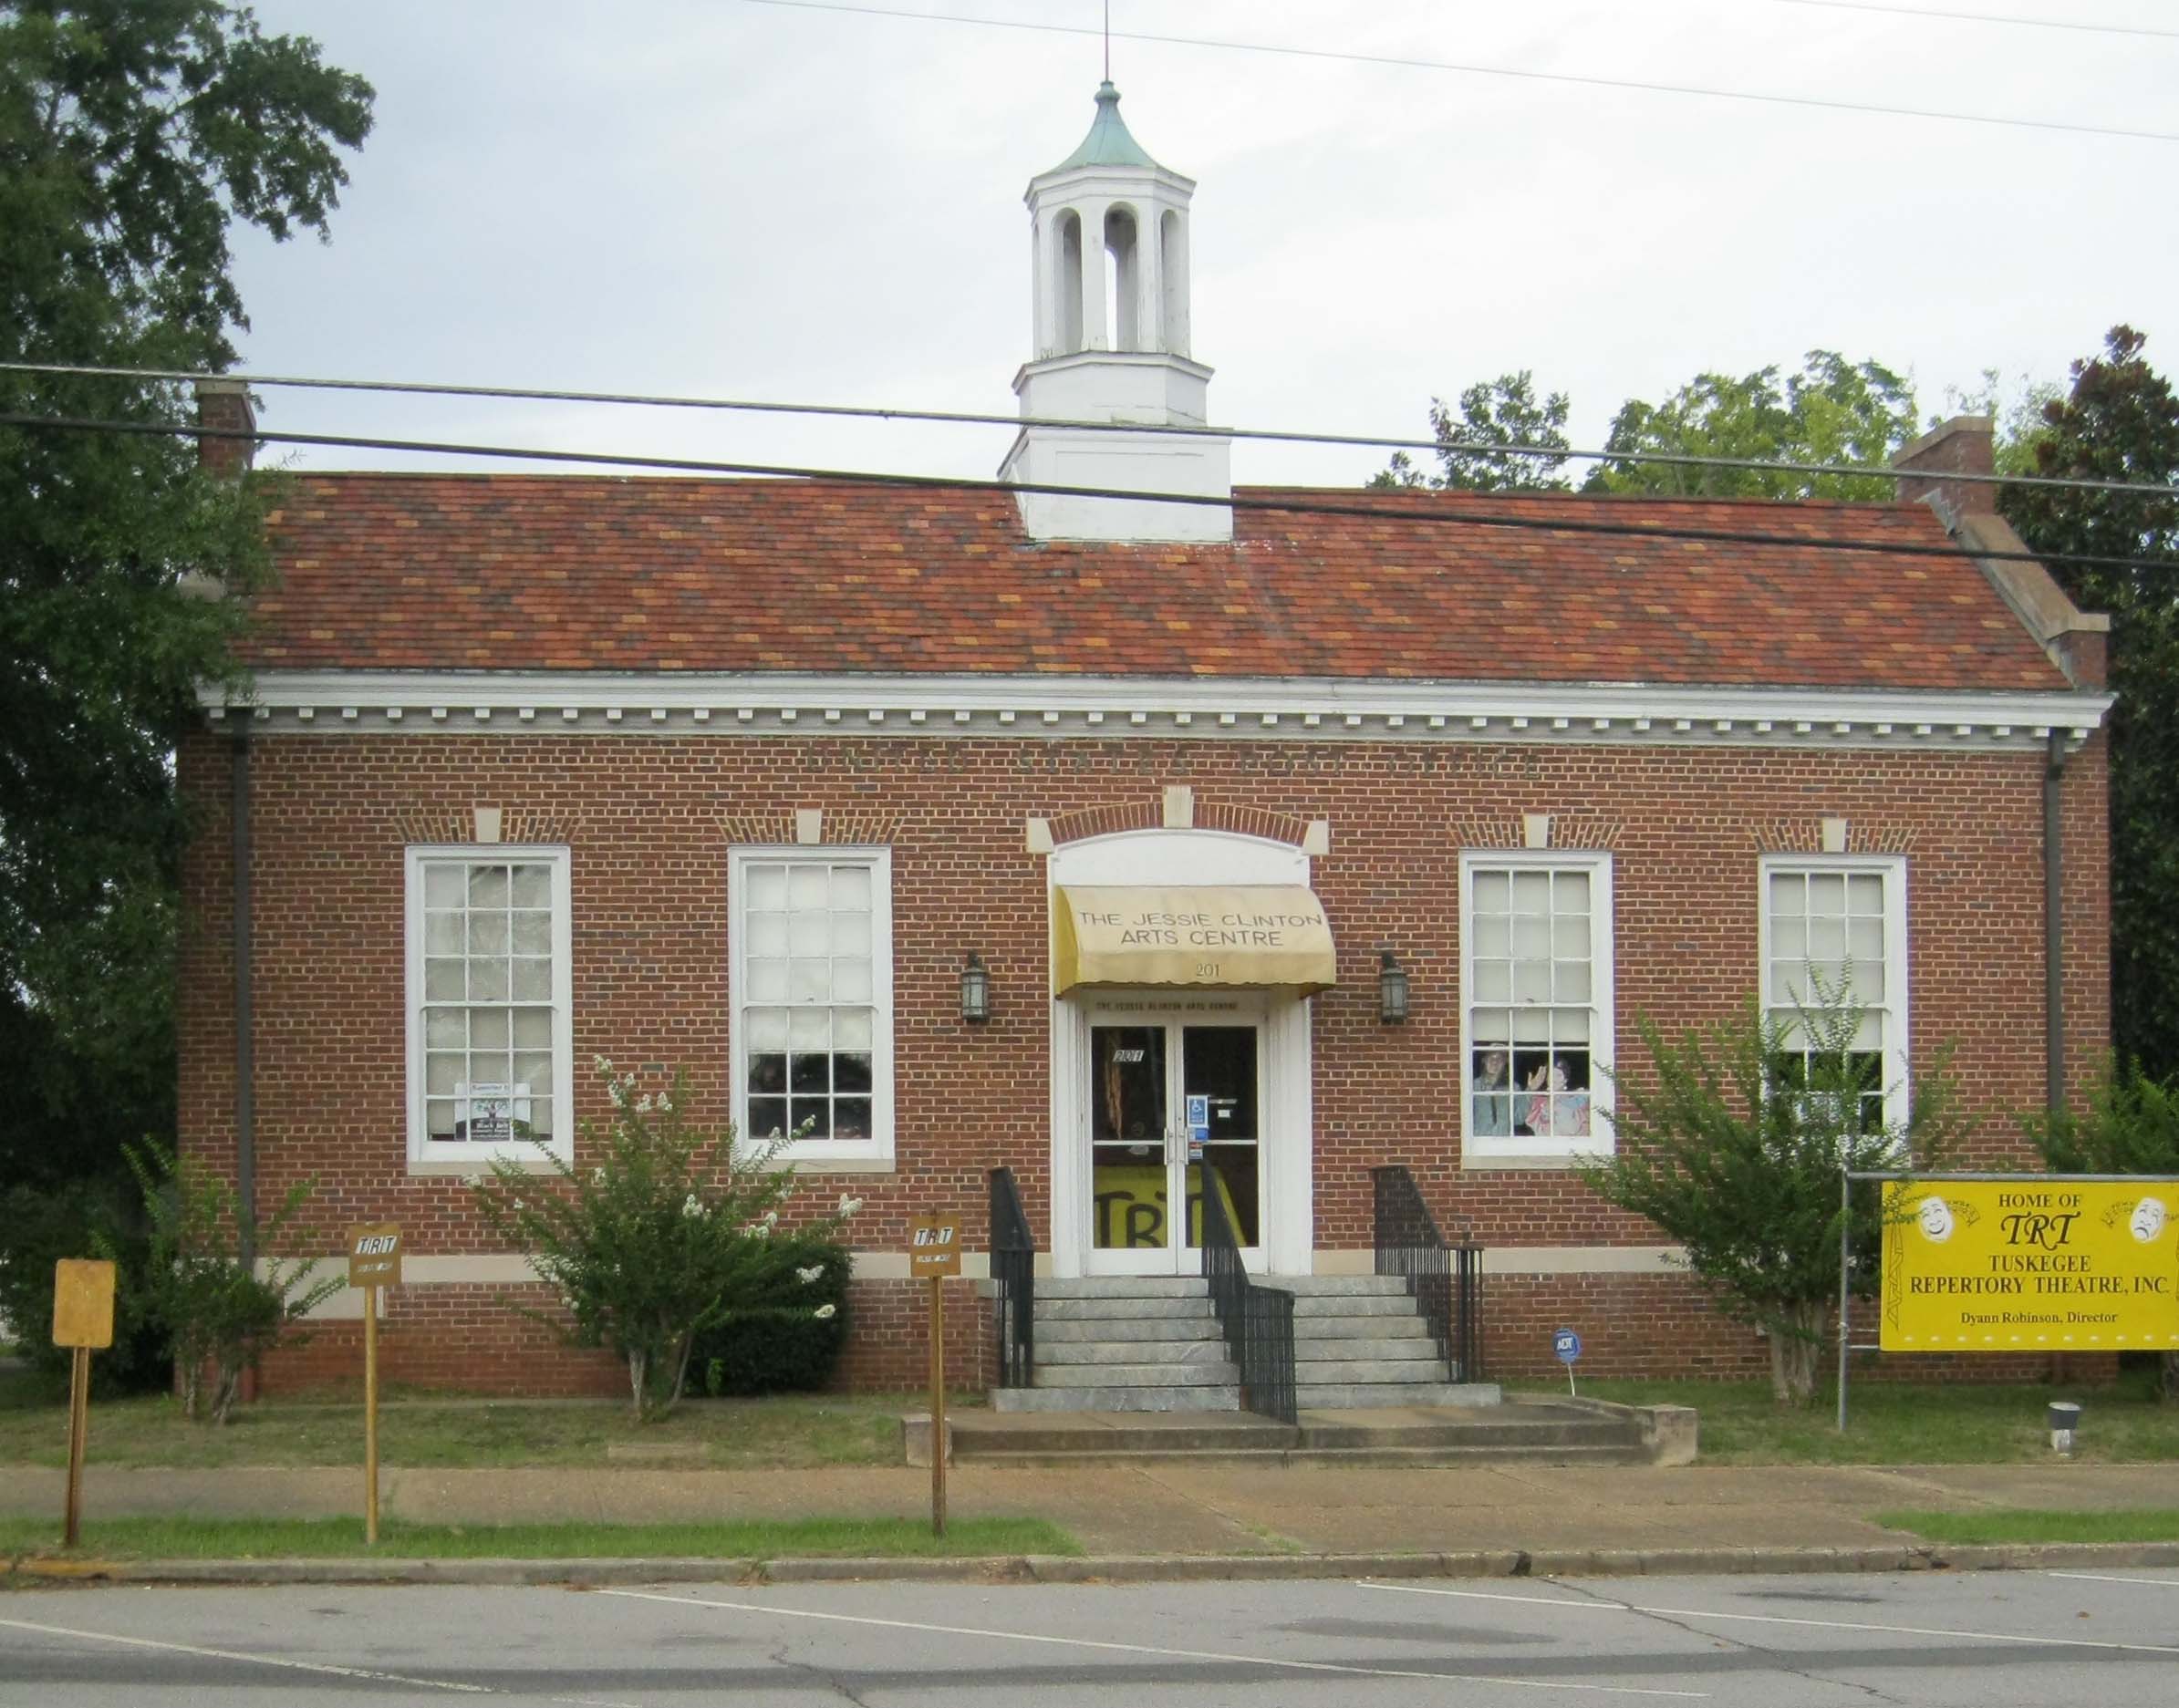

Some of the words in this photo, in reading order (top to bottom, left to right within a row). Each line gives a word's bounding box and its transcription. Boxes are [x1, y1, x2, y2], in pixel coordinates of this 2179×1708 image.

[1080, 912, 1123, 926] THE
[1132, 913, 1211, 926] JESSIE
[1221, 914, 1323, 927] CLINTON
[1120, 929, 1178, 945] ARTS
[1189, 930, 1284, 947] CENTRE
[1196, 963, 1220, 977] 201
[1114, 1050, 1145, 1062] 201
[1999, 1194, 2052, 1207] HOME
[2059, 1194, 2083, 1207] OF
[2000, 1211, 2081, 1251] TRT
[357, 1236, 397, 1254] TRT
[1989, 1255, 2091, 1272] TUSKEGEE
[1911, 1277, 2024, 1294] REPERTORY
[2035, 1277, 2129, 1295] THEATRE,
[2133, 1277, 2169, 1293] INC.
[1961, 1312, 1998, 1326] Dyann
[2002, 1312, 2063, 1324] Robinson,
[2067, 1311, 2118, 1323] Director
